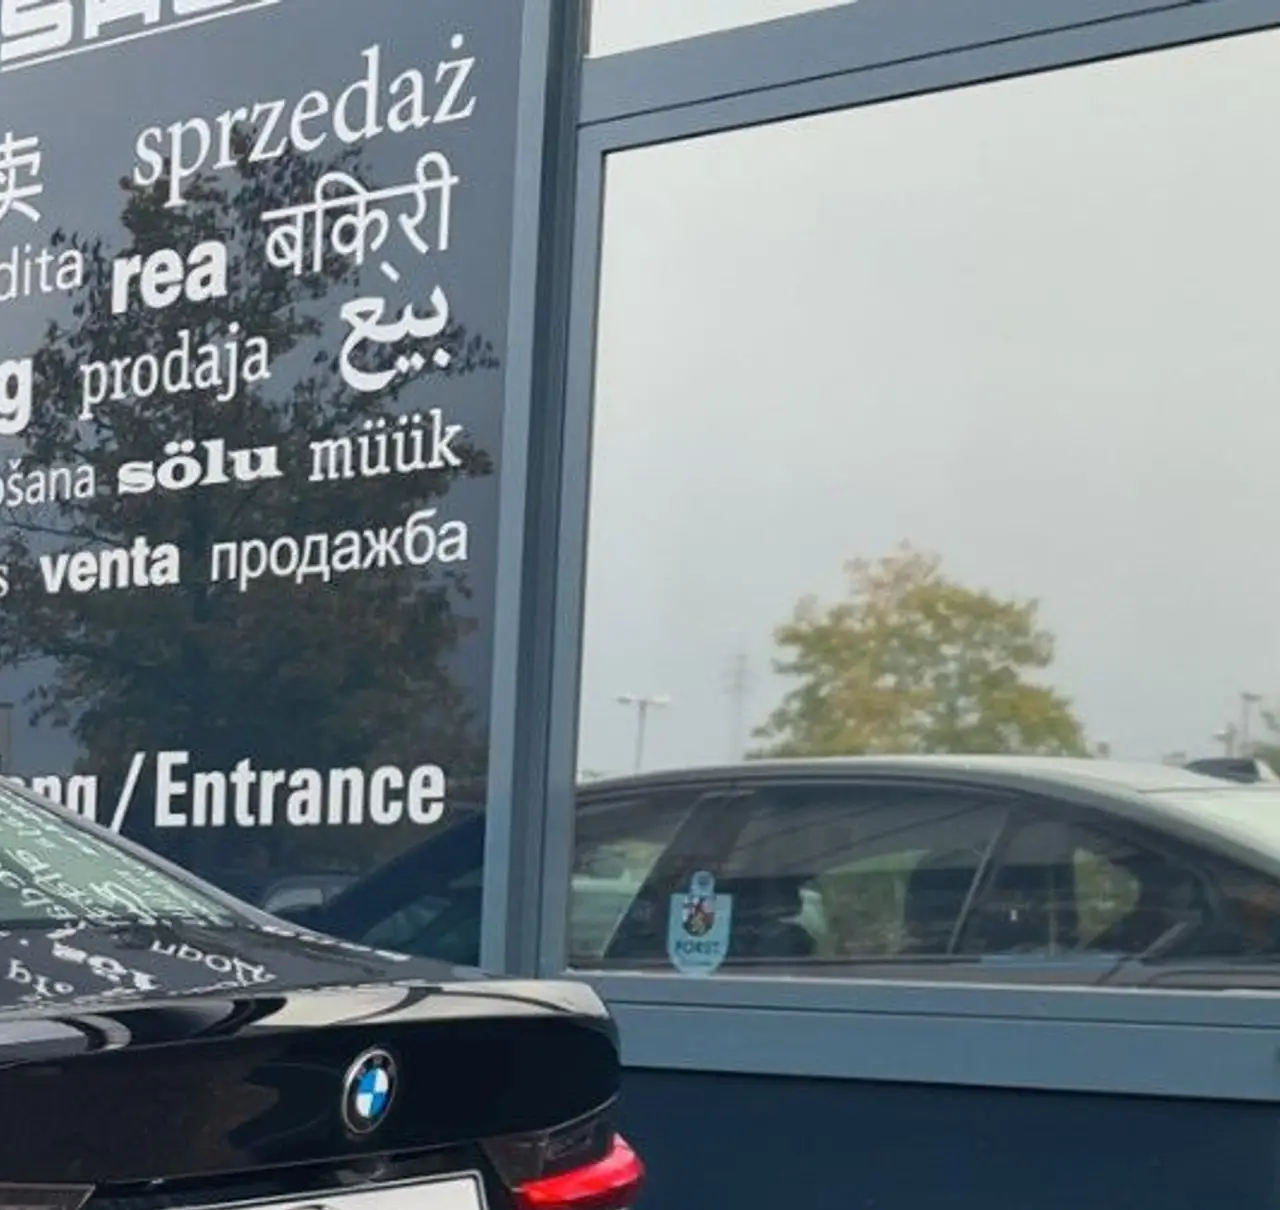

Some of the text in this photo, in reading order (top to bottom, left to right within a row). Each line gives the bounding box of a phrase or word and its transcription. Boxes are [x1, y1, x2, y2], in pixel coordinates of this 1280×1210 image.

[133, 33, 477, 208] sprzedaż
[111, 240, 228, 314] rea
[80, 321, 272, 422] prodaja
[117, 438, 283, 495] sölu
[308, 407, 464, 482] müük
[39, 536, 180, 593] venta
[211, 507, 468, 592] продажба
[155, 750, 446, 827] Entrance
